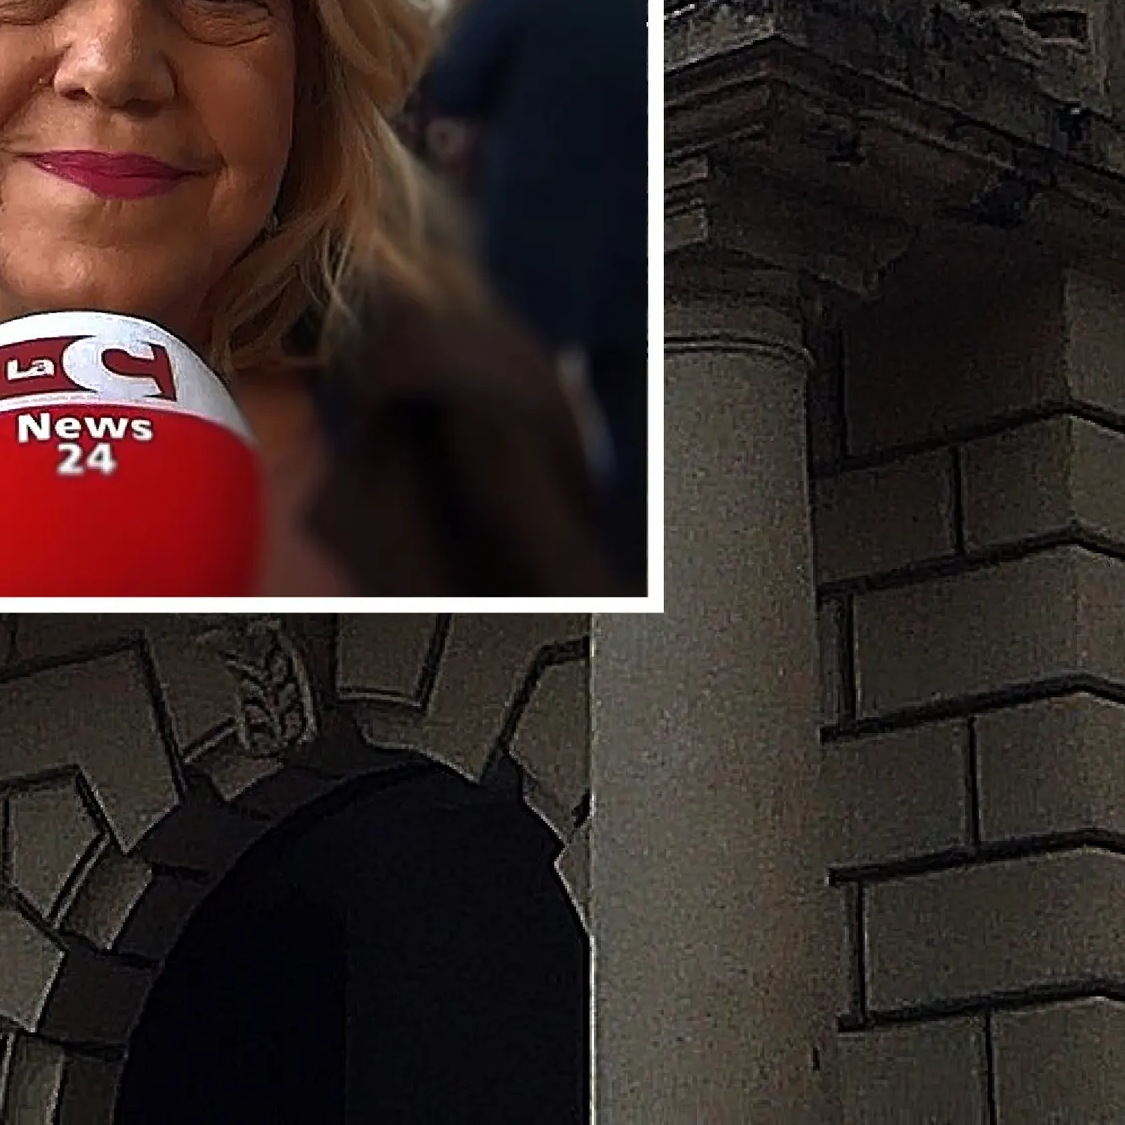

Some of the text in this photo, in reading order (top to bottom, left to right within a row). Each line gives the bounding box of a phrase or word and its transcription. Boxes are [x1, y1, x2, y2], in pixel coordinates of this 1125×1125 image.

[7, 359, 55, 381] La
[17, 412, 153, 443] News
[57, 442, 118, 475] 24
